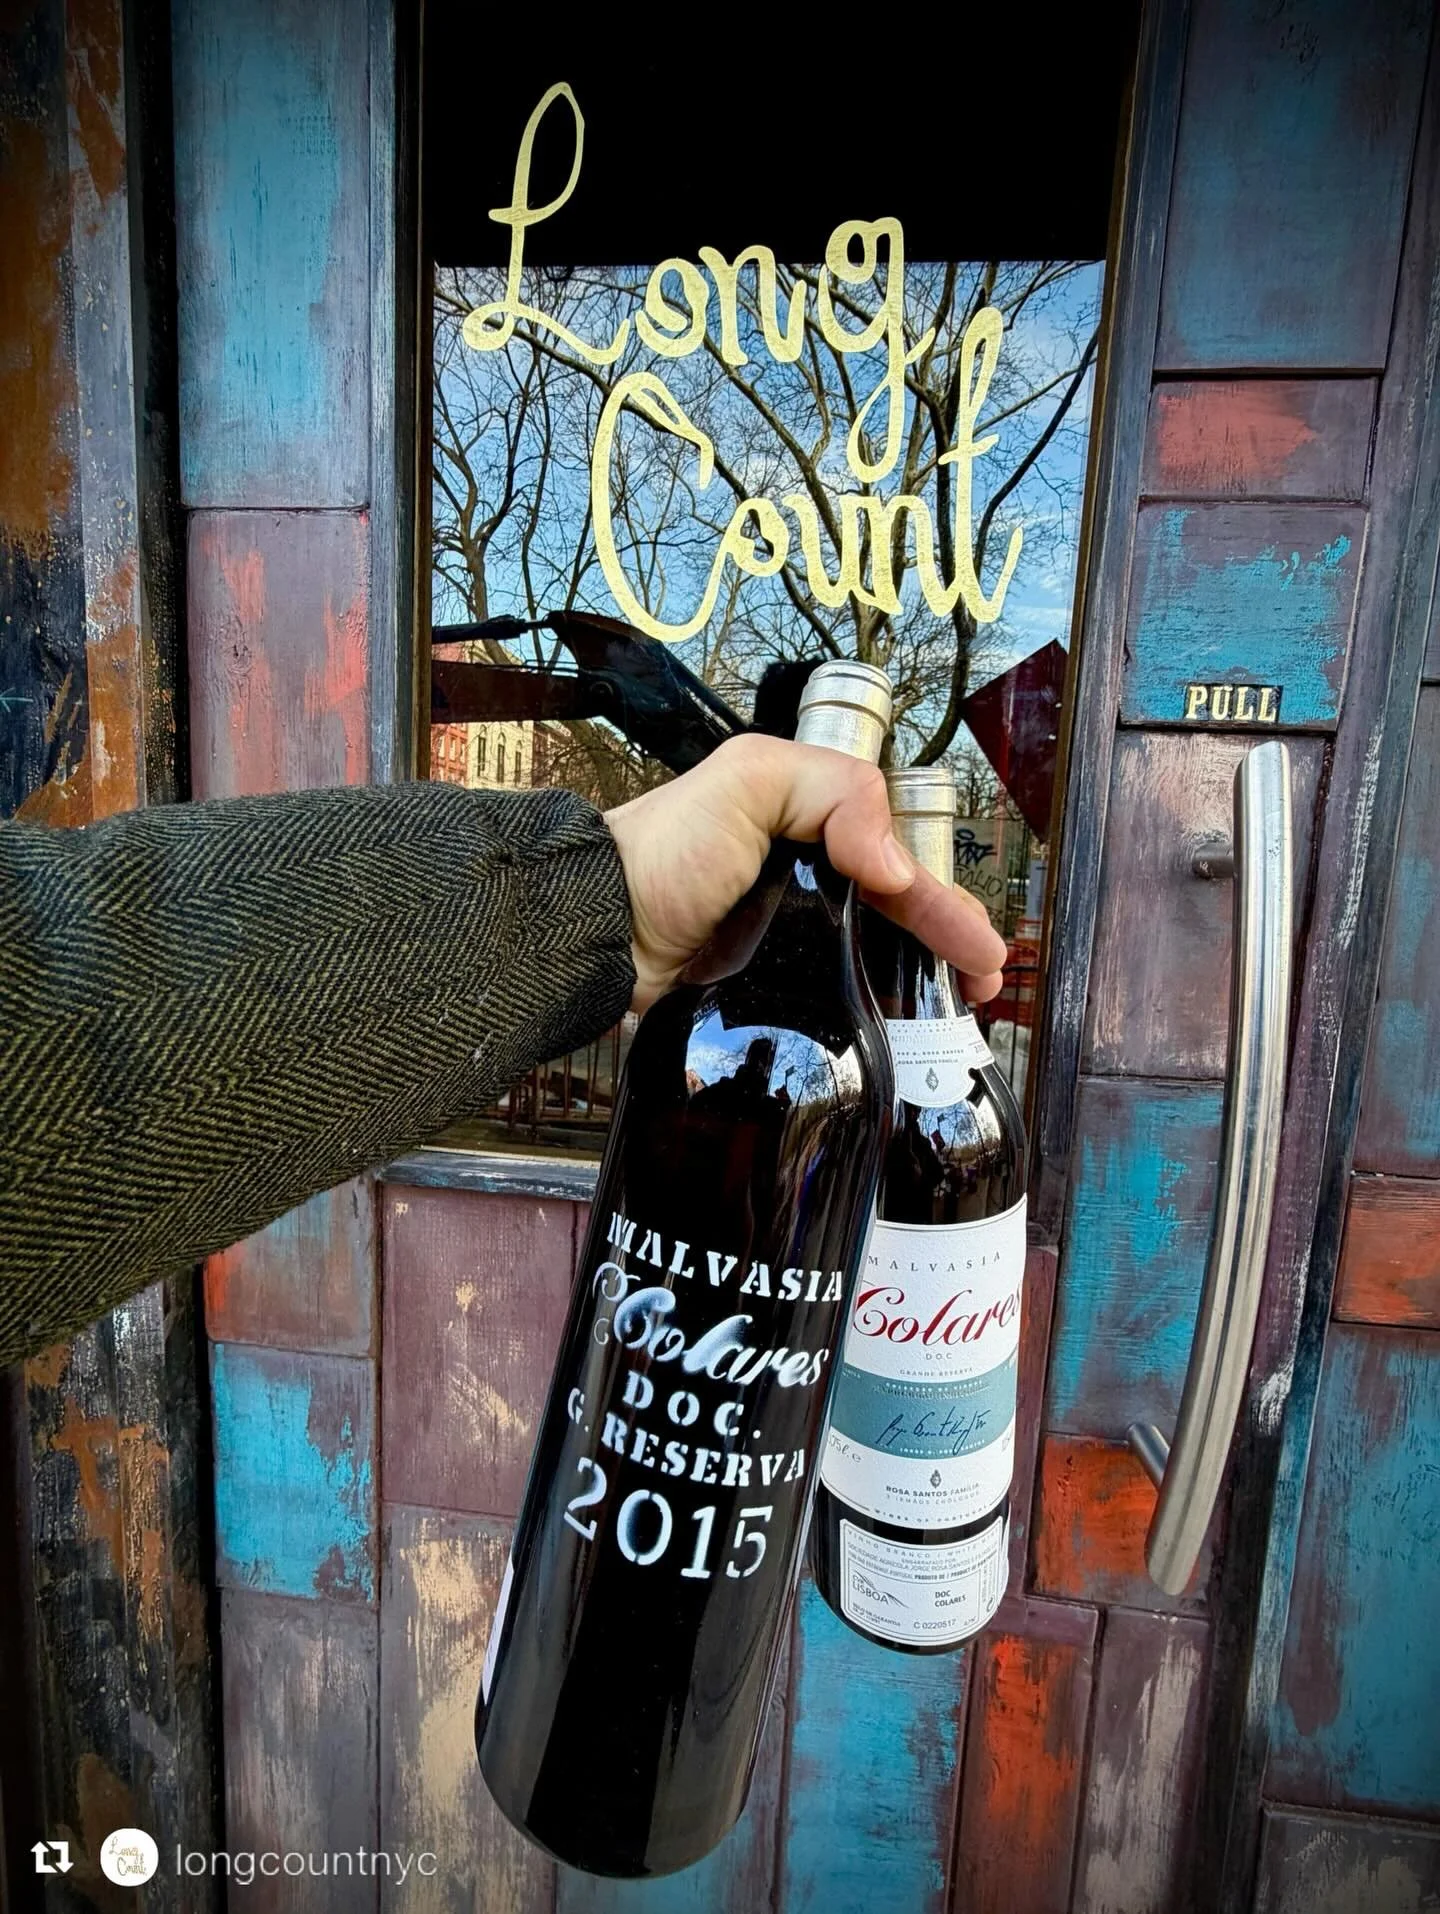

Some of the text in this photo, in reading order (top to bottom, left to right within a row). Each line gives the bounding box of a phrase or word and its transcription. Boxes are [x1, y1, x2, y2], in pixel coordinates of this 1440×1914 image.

[462, 82, 936, 484] Long
[591, 308, 1024, 643] Count
[1185, 685, 1278, 721] PULL
[606, 1211, 843, 1302] MALVASIA
[868, 1251, 1001, 1272] MALVASIA
[593, 1261, 830, 1389] Colares
[925, 1352, 953, 1360] DOC
[600, 1412, 805, 1488] RESERVA
[886, 1485, 910, 1496] ROSA
[563, 1457, 774, 1580] 2015
[853, 1579, 889, 1606] LISBOA
[935, 1589, 951, 1599] DOC
[935, 1594, 967, 1608] COLARES
[914, 1621, 921, 1629] C
[922, 1618, 957, 1630] 0220517
